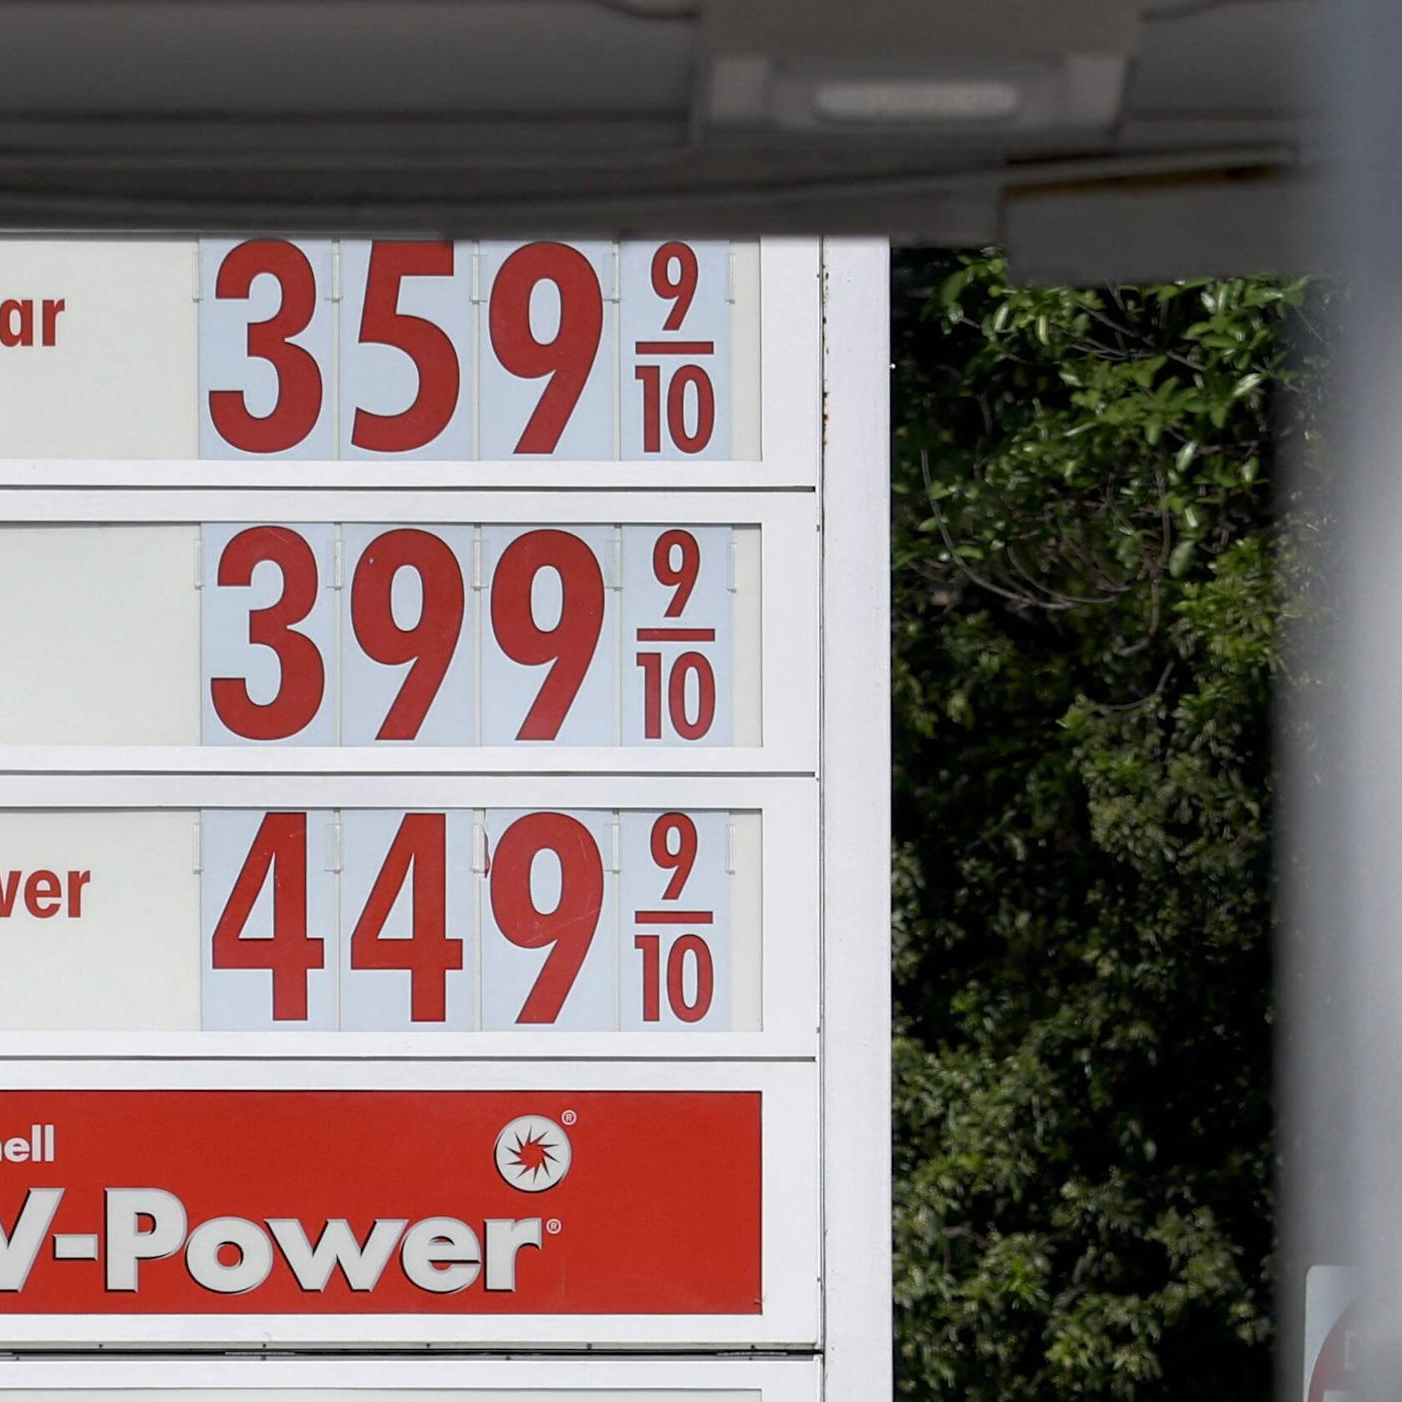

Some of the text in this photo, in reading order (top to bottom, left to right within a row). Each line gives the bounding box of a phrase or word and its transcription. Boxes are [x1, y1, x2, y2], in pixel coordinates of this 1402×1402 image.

[210, 240, 603, 454] 359
[211, 526, 605, 741] 399
[211, 811, 605, 1025] 449
